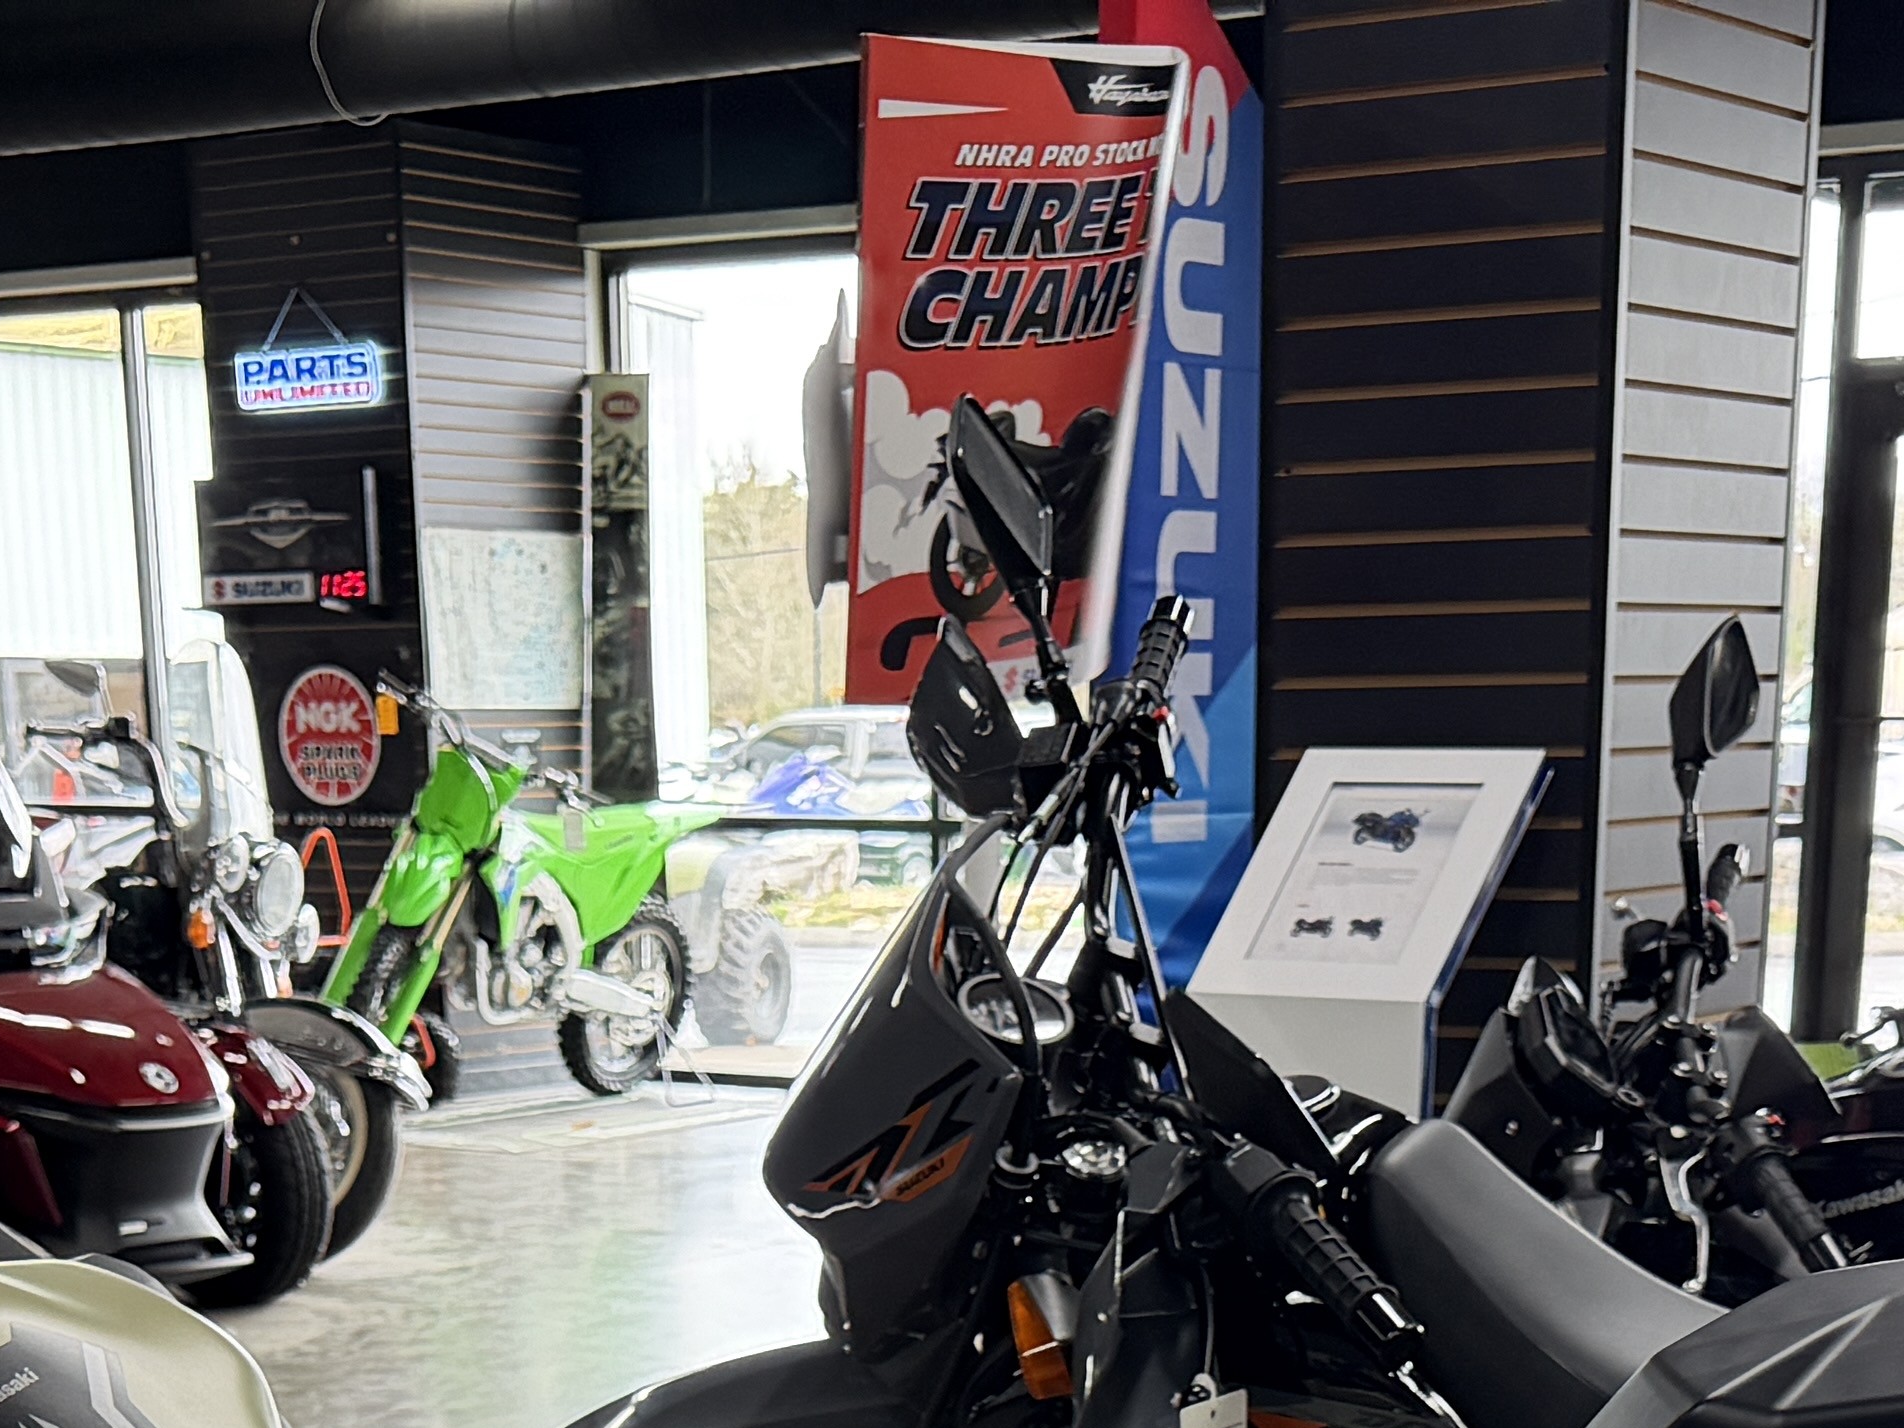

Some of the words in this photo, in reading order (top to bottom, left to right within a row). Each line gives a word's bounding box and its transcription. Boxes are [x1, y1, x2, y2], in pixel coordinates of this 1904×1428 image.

[955, 143, 1034, 167] NHRA
[1039, 145, 1091, 168] PRO
[1092, 139, 1147, 166] STOCK
[904, 171, 1146, 261] THREE
[899, 252, 1147, 351] CHAMP
[243, 352, 369, 387] PARTS
[232, 579, 305, 598] SUZUKI
[294, 701, 362, 733] NGK
[896, 1157, 946, 1197] SUZUKI
